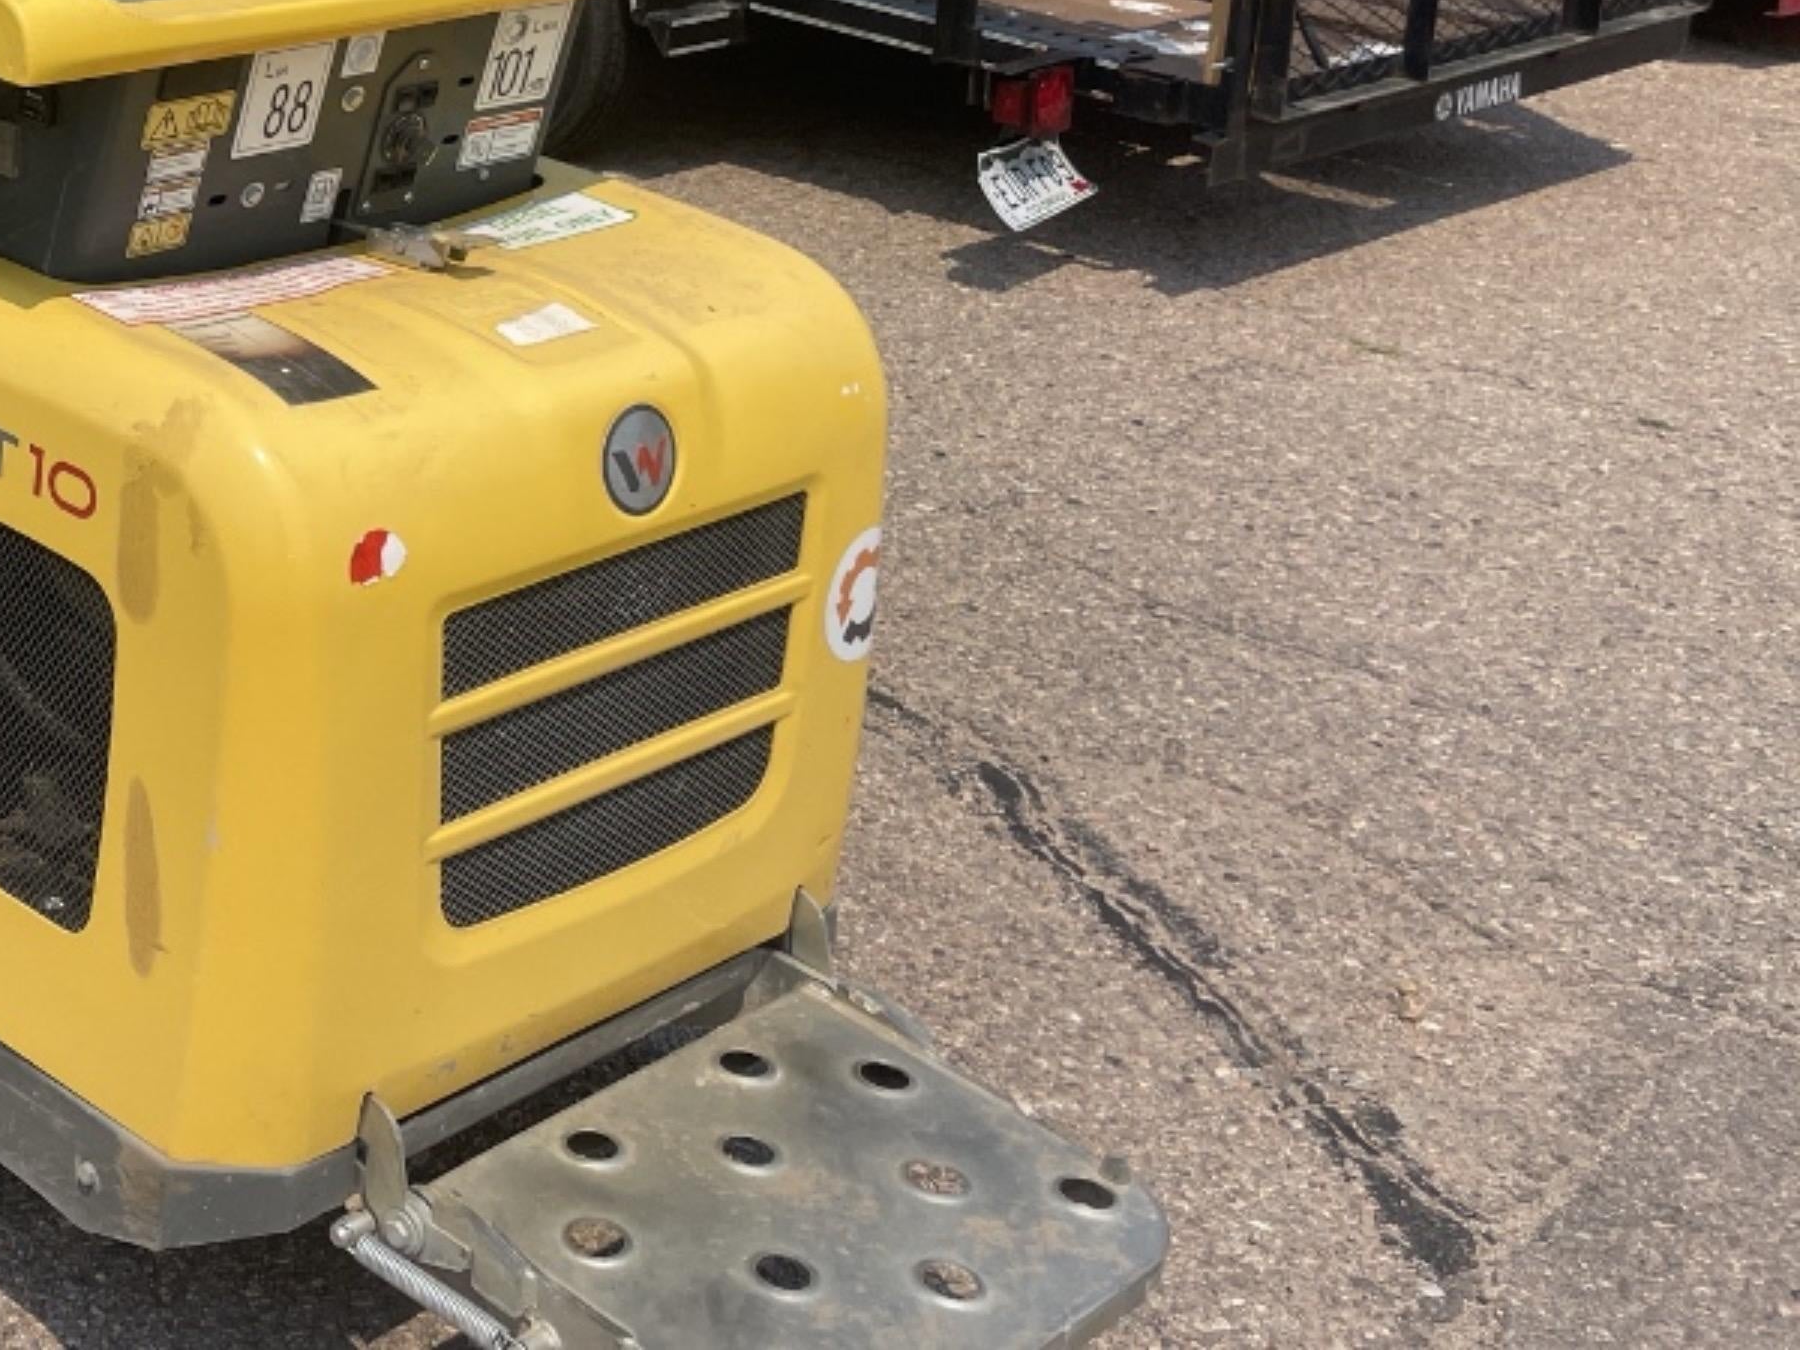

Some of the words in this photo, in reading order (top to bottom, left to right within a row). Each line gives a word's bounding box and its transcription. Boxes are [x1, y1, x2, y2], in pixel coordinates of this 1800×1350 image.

[488, 44, 537, 99] 101
[1456, 71, 1521, 115] YAMAHA
[263, 80, 313, 139] 88
